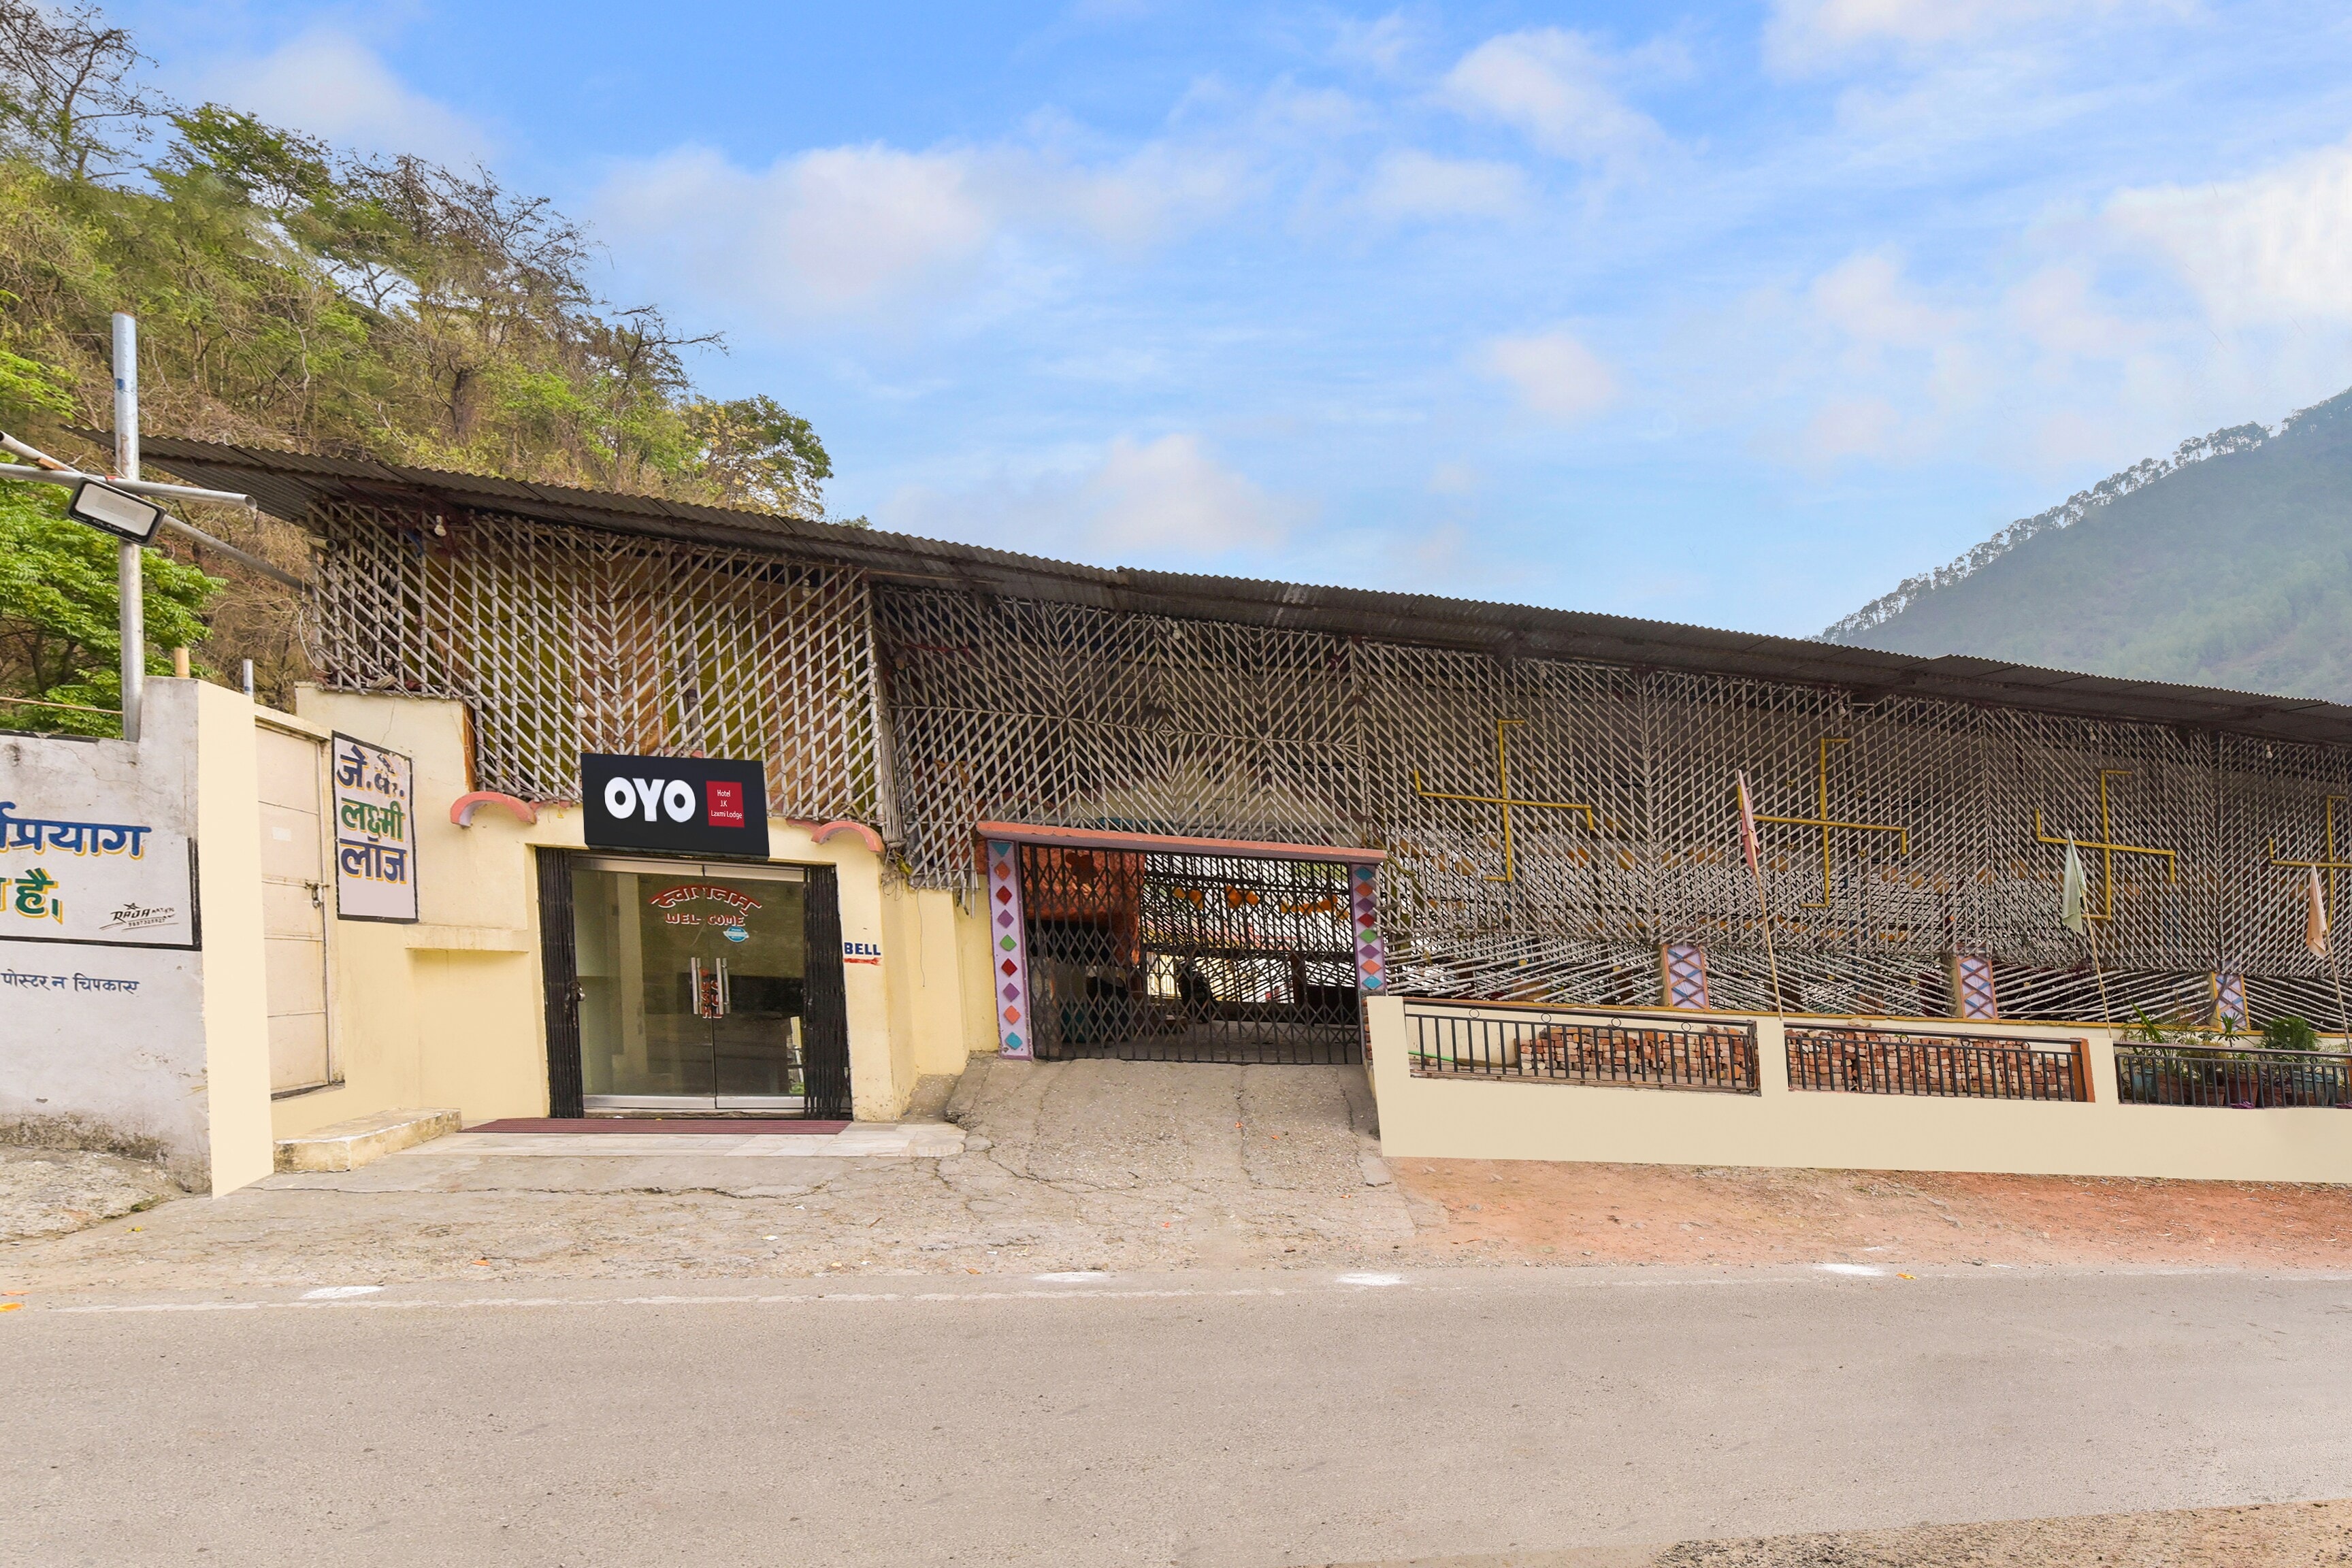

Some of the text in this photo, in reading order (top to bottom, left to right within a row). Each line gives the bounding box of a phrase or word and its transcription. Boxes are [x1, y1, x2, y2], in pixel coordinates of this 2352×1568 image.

[604, 777, 696, 822] OYO
[726, 811, 742, 820] Lodge
[110, 909, 150, 924] RAJA
[844, 942, 881, 956] BELL
[0, 968, 51, 991] पोस्टर
[51, 976, 69, 989] न
